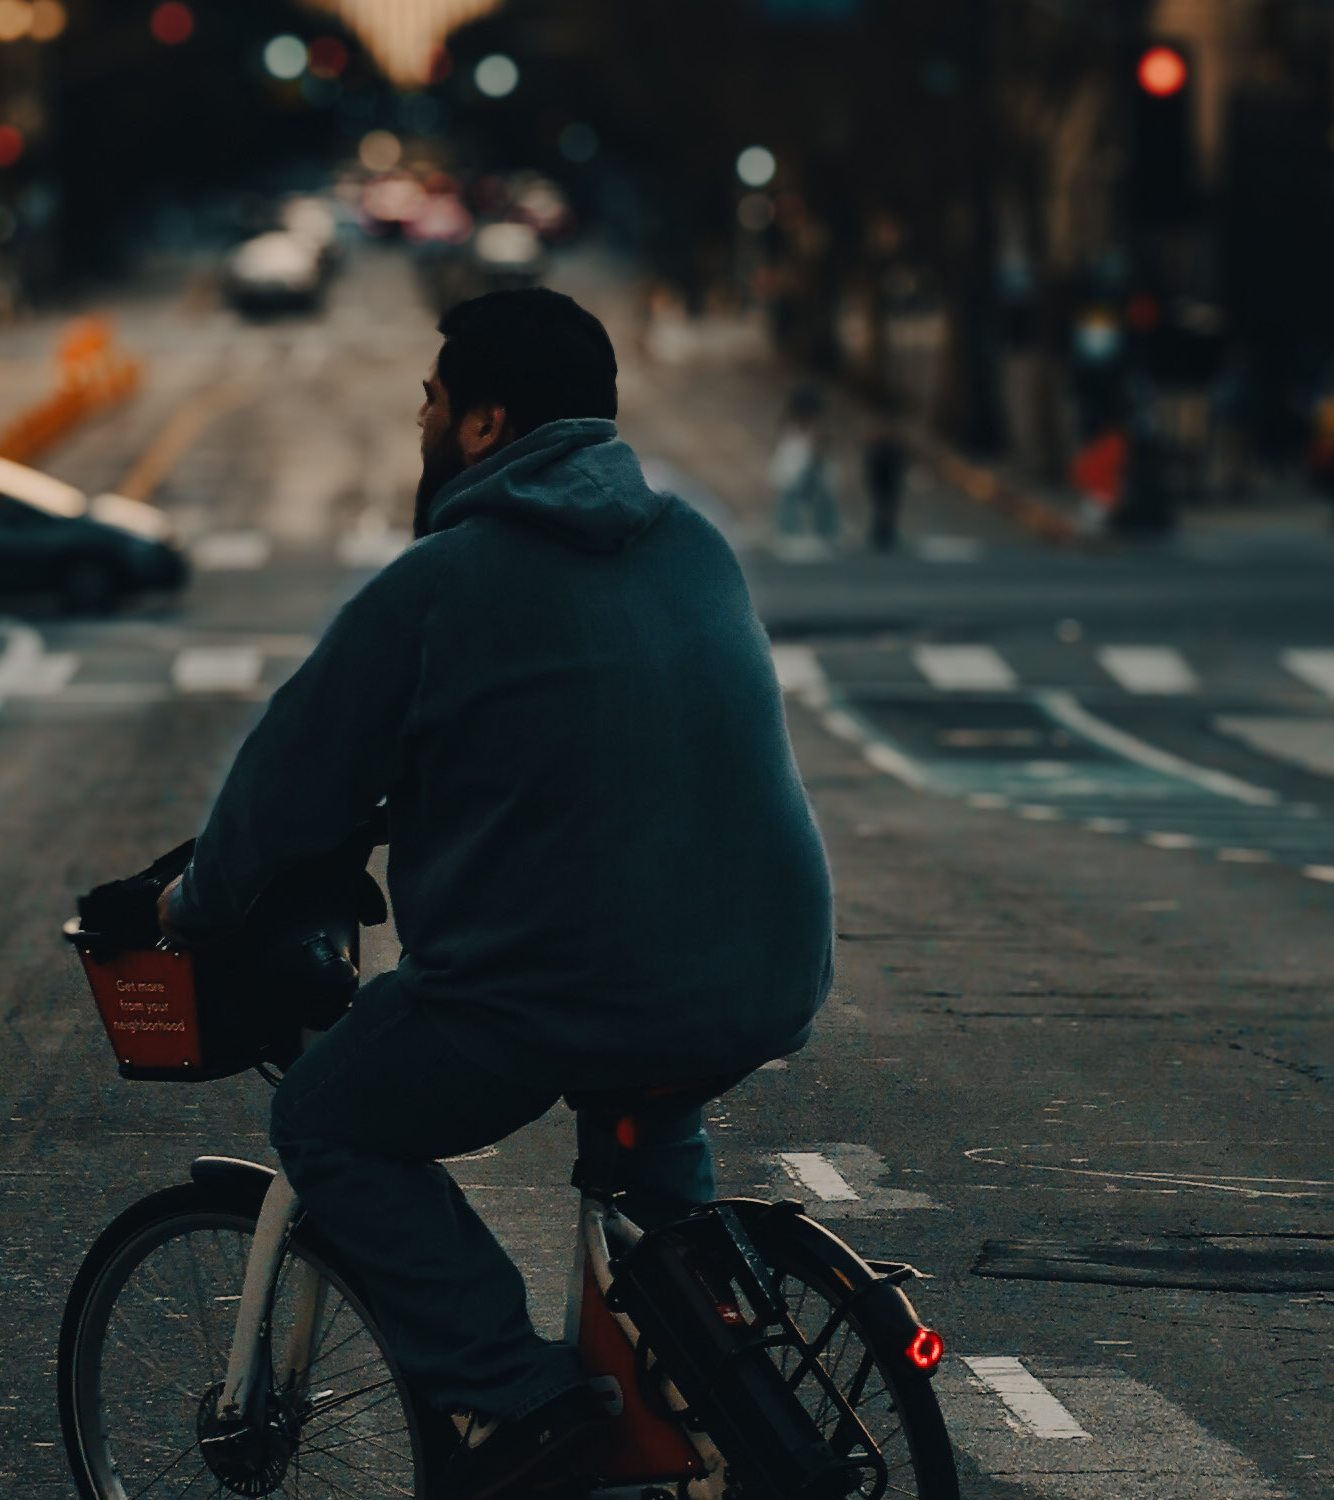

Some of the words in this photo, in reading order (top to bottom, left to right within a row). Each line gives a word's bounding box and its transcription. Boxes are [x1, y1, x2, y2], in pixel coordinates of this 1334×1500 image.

[116, 979, 136, 992] Get
[138, 983, 165, 993] more
[119, 999, 145, 1011] from
[146, 1001, 170, 1015] your
[113, 1018, 186, 1034] neighborhood
